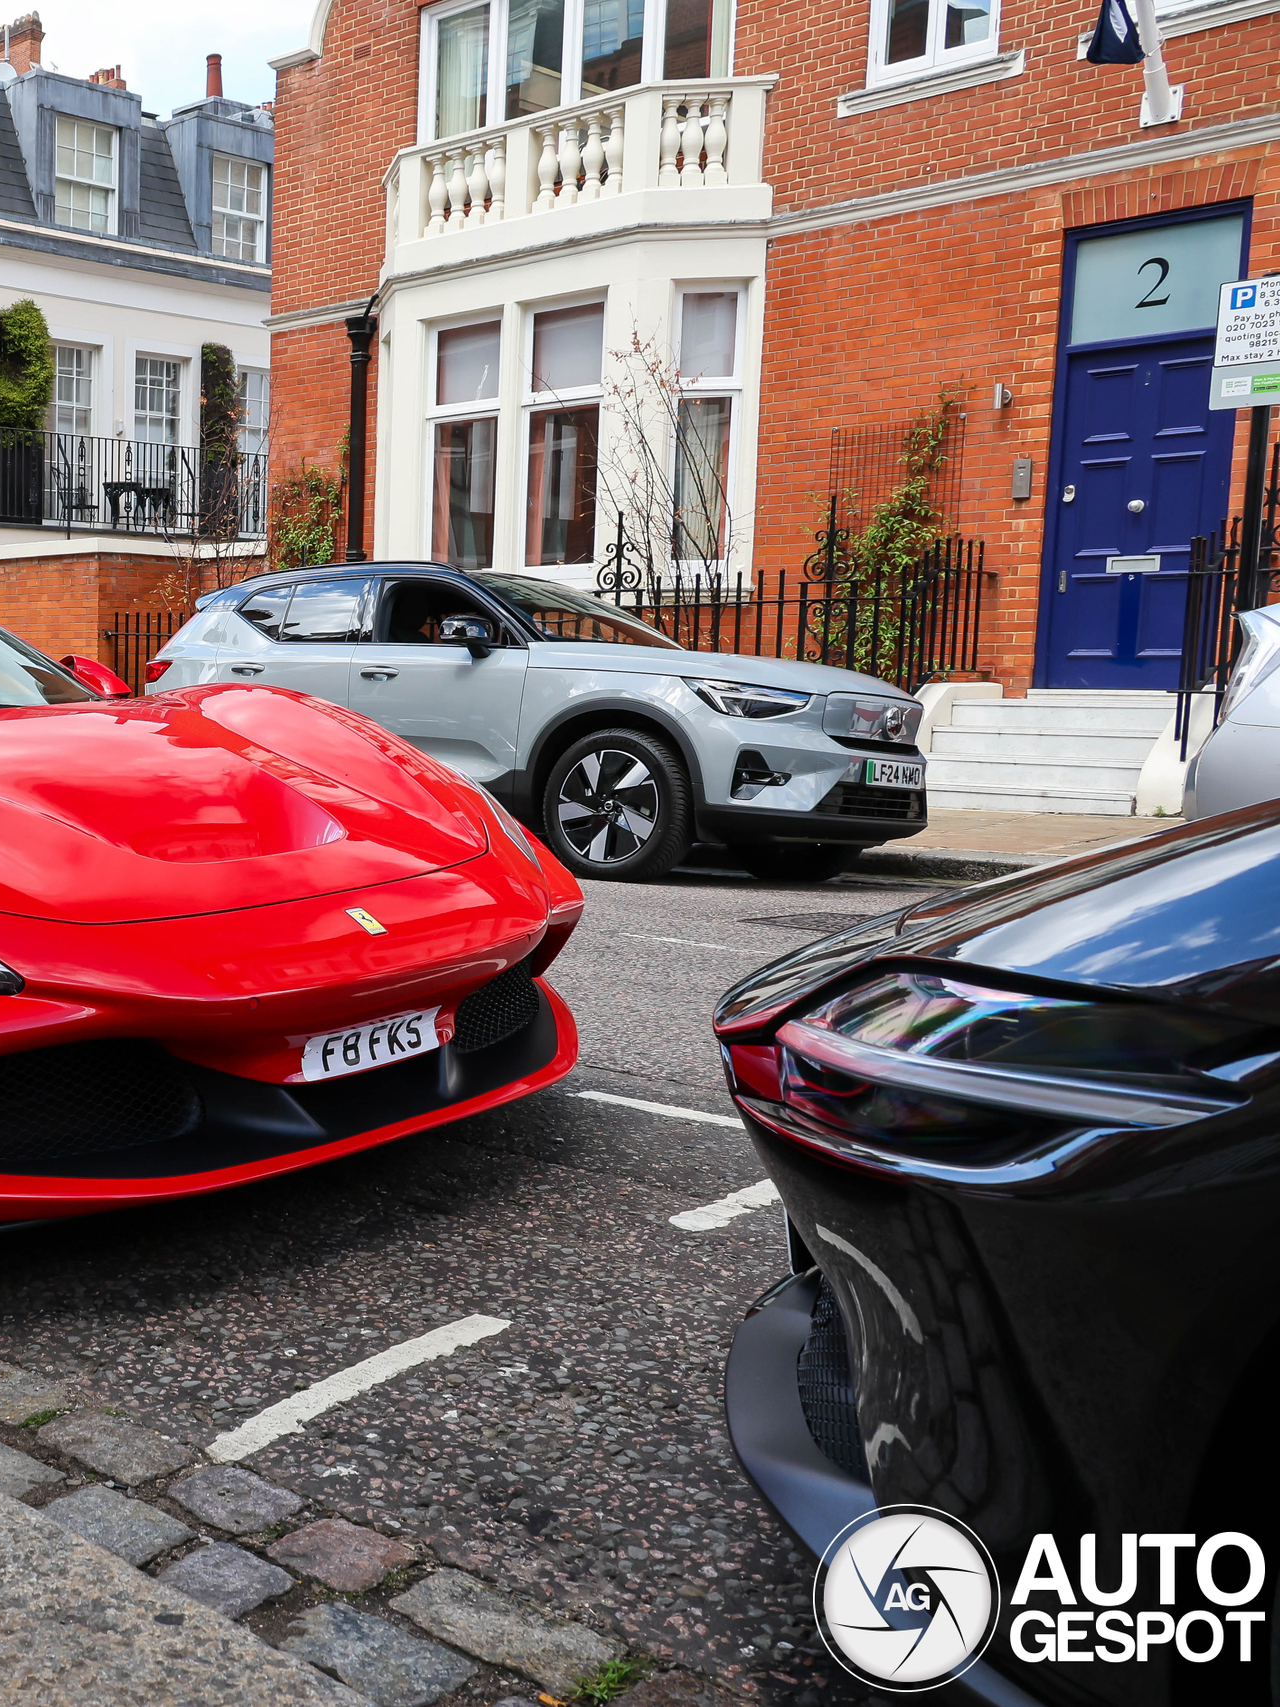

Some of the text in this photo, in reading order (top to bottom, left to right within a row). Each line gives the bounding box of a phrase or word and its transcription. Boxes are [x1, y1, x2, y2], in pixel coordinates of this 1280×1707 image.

[1134, 257, 1171, 309] 2
[1236, 288, 1254, 308] P
[1234, 315, 1251, 323] Pay
[1255, 313, 1266, 321] by
[1225, 319, 1275, 332] 020 7023
[1225, 332, 1261, 343] quoting
[1249, 338, 1278, 348] 98215
[1244, 352, 1264, 360] stay
[1267, 349, 1274, 357] 2
[873, 763, 900, 783] LF24
[322, 1015, 422, 1072] F8 FKS
